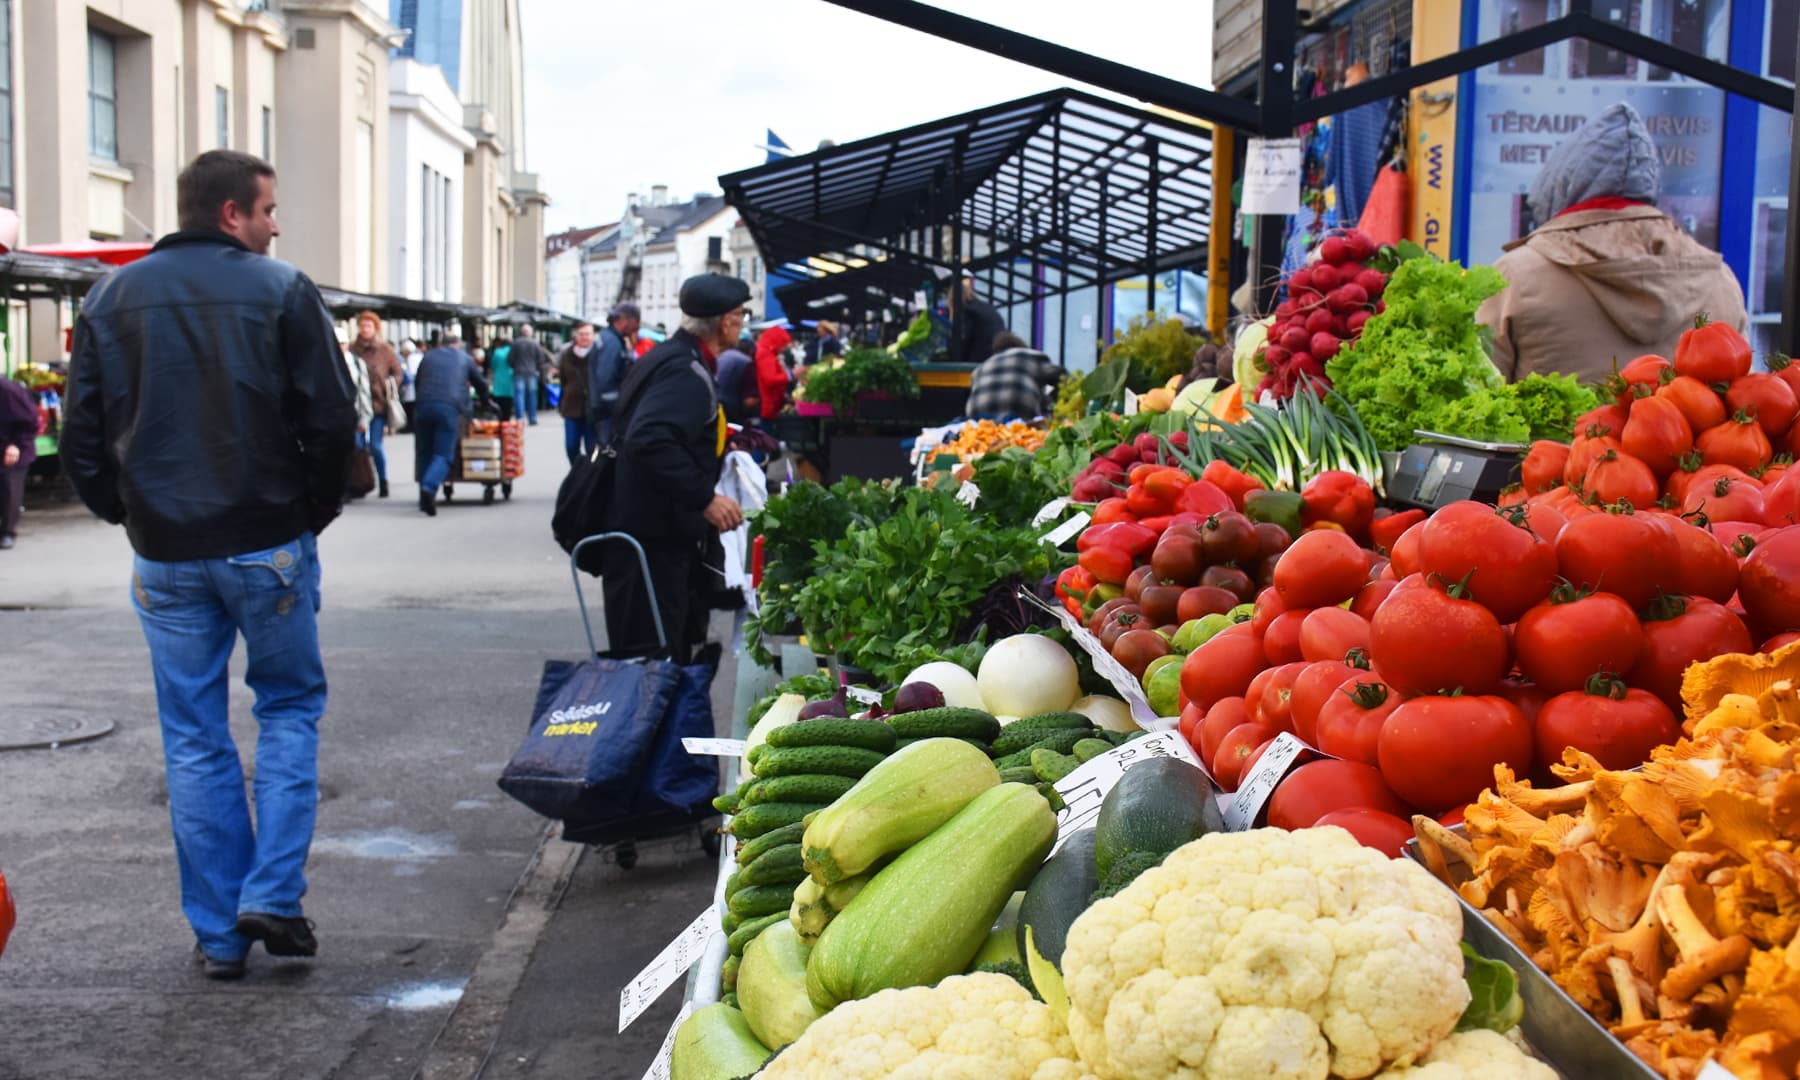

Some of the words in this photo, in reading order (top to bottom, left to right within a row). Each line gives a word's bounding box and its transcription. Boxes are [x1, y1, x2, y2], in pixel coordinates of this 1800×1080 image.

[1500, 143, 1560, 163] MET
[1657, 145, 1697, 167] VIS
[1424, 211, 1440, 252] .GL
[543, 721, 598, 737] market
